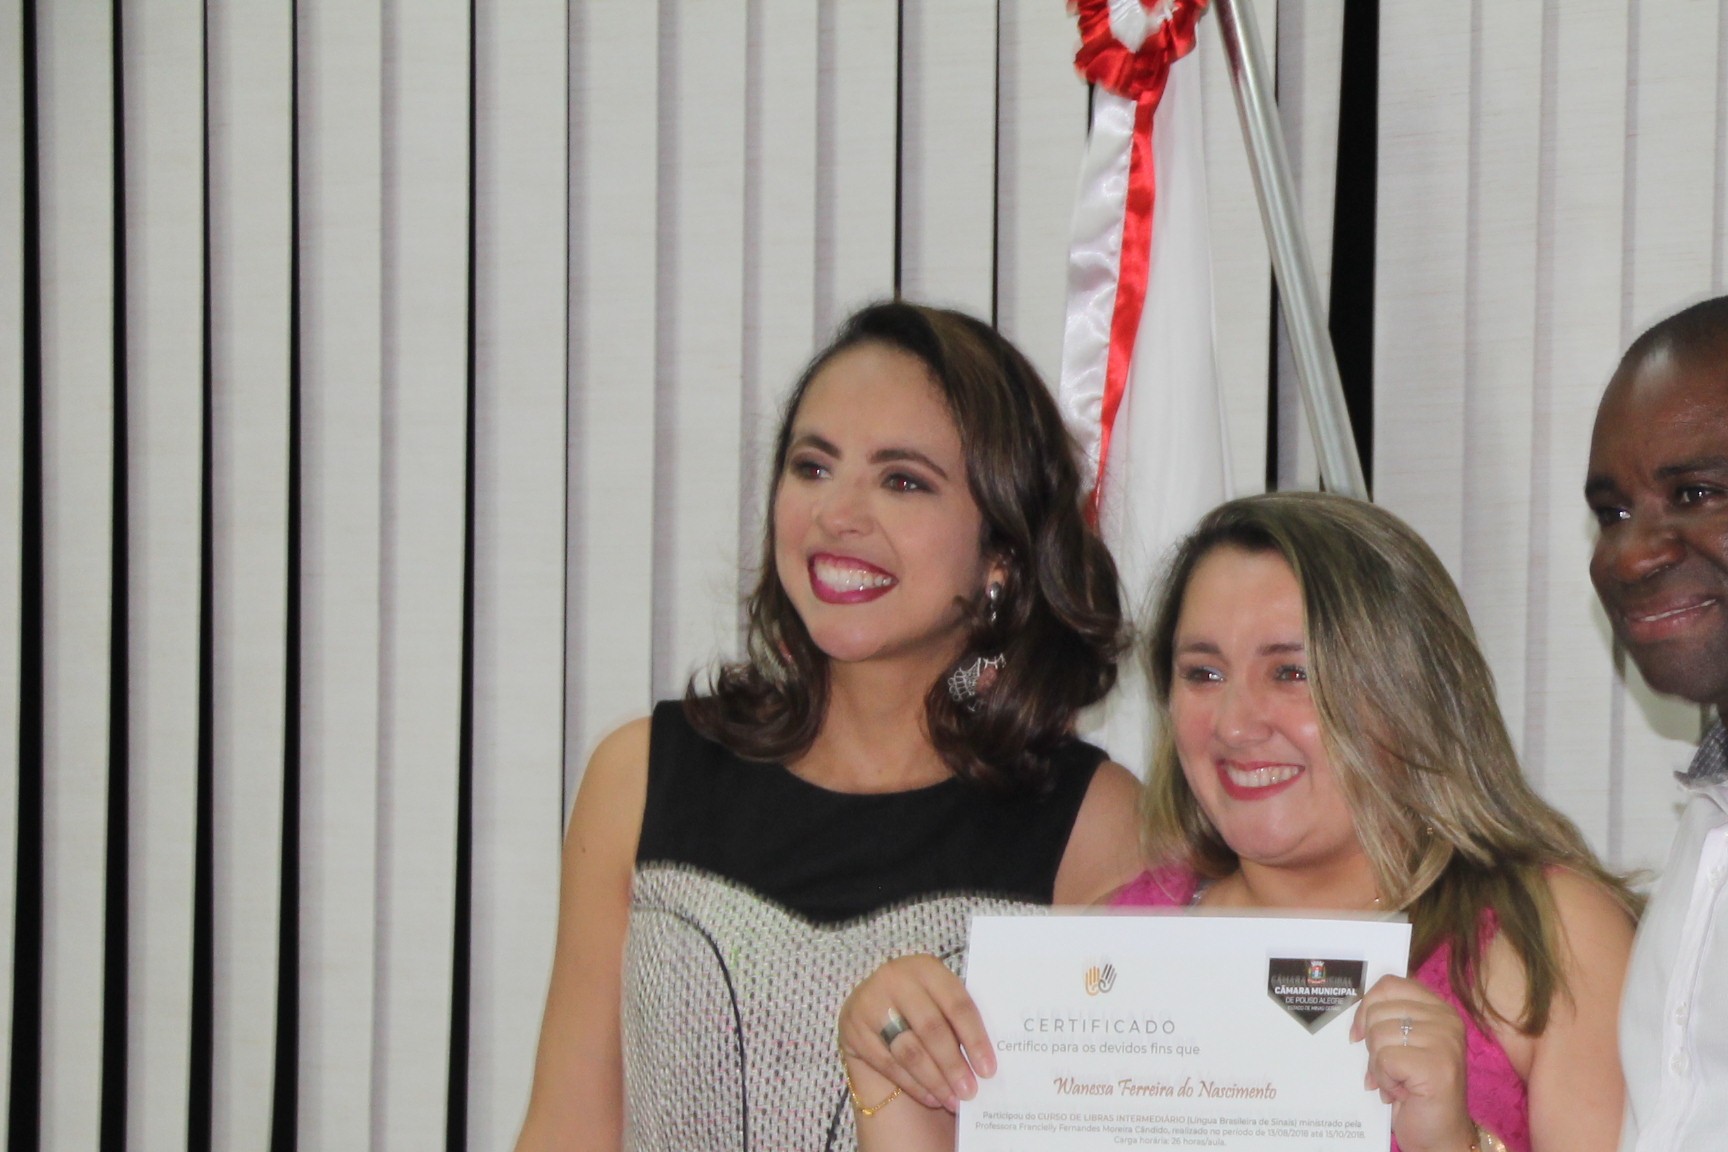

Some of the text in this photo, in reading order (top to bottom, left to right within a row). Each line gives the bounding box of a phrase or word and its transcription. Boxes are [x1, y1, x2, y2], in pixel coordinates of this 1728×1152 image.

[1274, 984, 1357, 996] CÂMARA MUNICIPAL
[1285, 996, 1295, 1004] DE
[1295, 996, 1319, 1004] POUSO
[1023, 1018, 1176, 1034] CERTIFICADO
[996, 1040, 1201, 1057] Certifico para os devidos fins que
[1053, 1076, 1278, 1100] Wanessa Ferreira do Nascimento
[982, 1111, 1023, 1122] Participou
[1025, 1112, 1036, 1120] do
[1037, 1112, 1068, 1121] CURSO
[1069, 1113, 1082, 1122] DE
[1084, 1113, 1114, 1122] LIBRAS
[1116, 1113, 1186, 1124] INTERMEDIÁRIO
[1219, 1117, 1257, 1126] Brasileira
[1258, 1118, 1269, 1126] de
[1271, 1118, 1297, 1128] Sinais)
[1299, 1119, 1343, 1128] ministrado
[1345, 1120, 1362, 1129] pela
[975, 1122, 1017, 1131] Professora
[1019, 1123, 1057, 1134] Francielly
[1059, 1124, 1101, 1133] Fernandes
[1103, 1125, 1133, 1134] Moreira
[1172, 1127, 1208, 1136] realizado
[1255, 1128, 1266, 1136] de
[1311, 1129, 1324, 1138] até
[1114, 1136, 1137, 1146] Carga
[1171, 1136, 1181, 1145] 26
